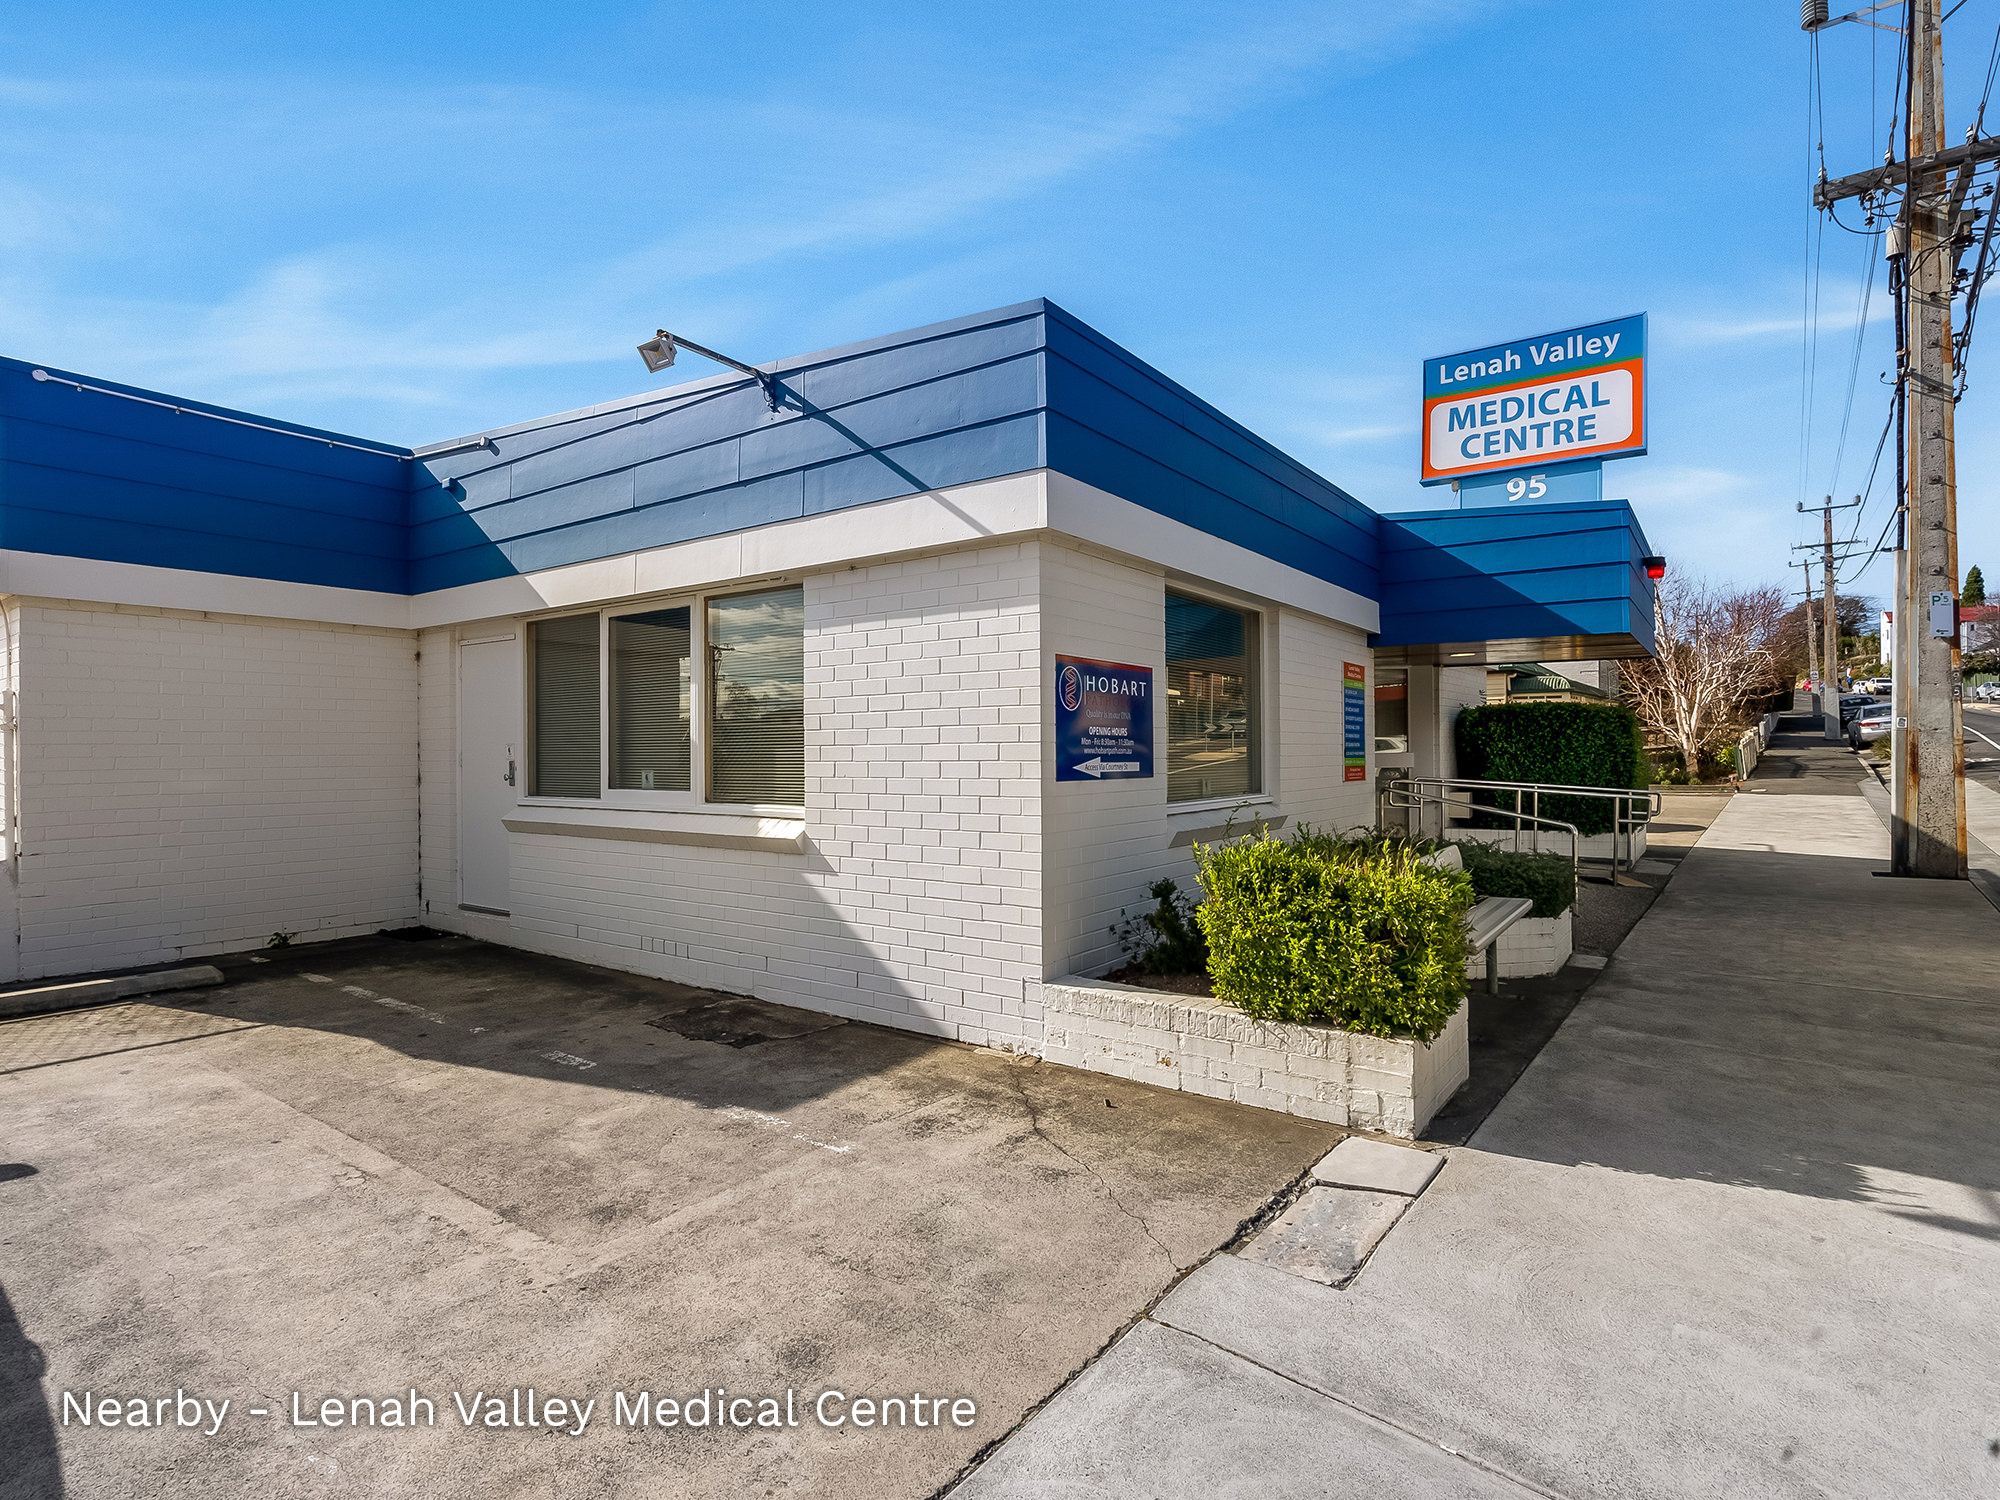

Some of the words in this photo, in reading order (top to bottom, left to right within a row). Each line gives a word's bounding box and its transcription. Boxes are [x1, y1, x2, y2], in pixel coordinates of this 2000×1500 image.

[1440, 350, 1521, 384] Lenah
[1529, 333, 1620, 366] Valley
[1448, 381, 1610, 432] MEDICAL
[1460, 414, 1596, 459] CENTRE
[1506, 474, 1547, 501] 95
[1932, 595, 1941, 606] P
[1086, 675, 1147, 697] HOBART
[1089, 726, 1111, 736] OPENING
[1111, 727, 1128, 736] HOURS
[1085, 763, 1099, 771] Access
